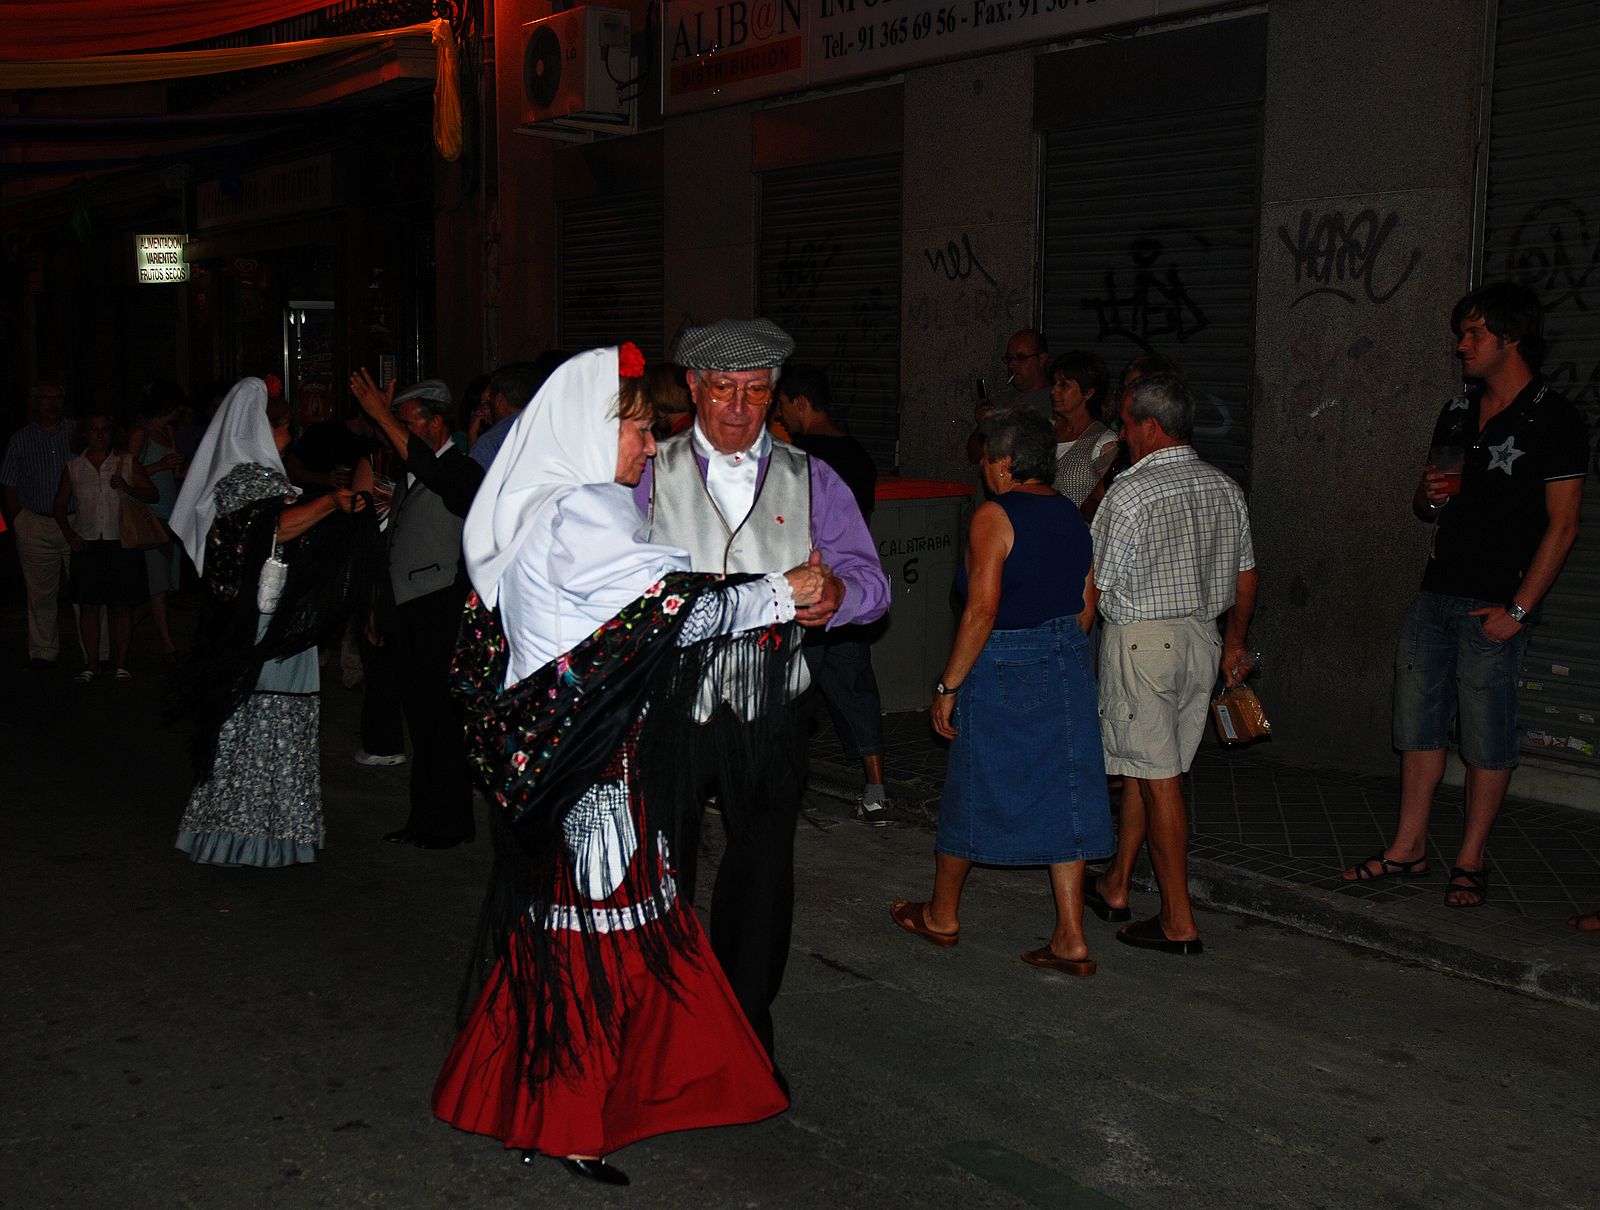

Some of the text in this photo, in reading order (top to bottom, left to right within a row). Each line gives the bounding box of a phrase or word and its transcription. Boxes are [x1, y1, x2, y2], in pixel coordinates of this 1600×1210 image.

[857, 24, 874, 52] 91
[880, 17, 908, 48] 365
[912, 12, 931, 41] 69
[936, 6, 956, 35] 56
[973, 0, 1012, 27] Fax:
[566, 47, 577, 60] LG
[140, 267, 186, 281] FRUTOS SECOS
[903, 557, 919, 585] 6
